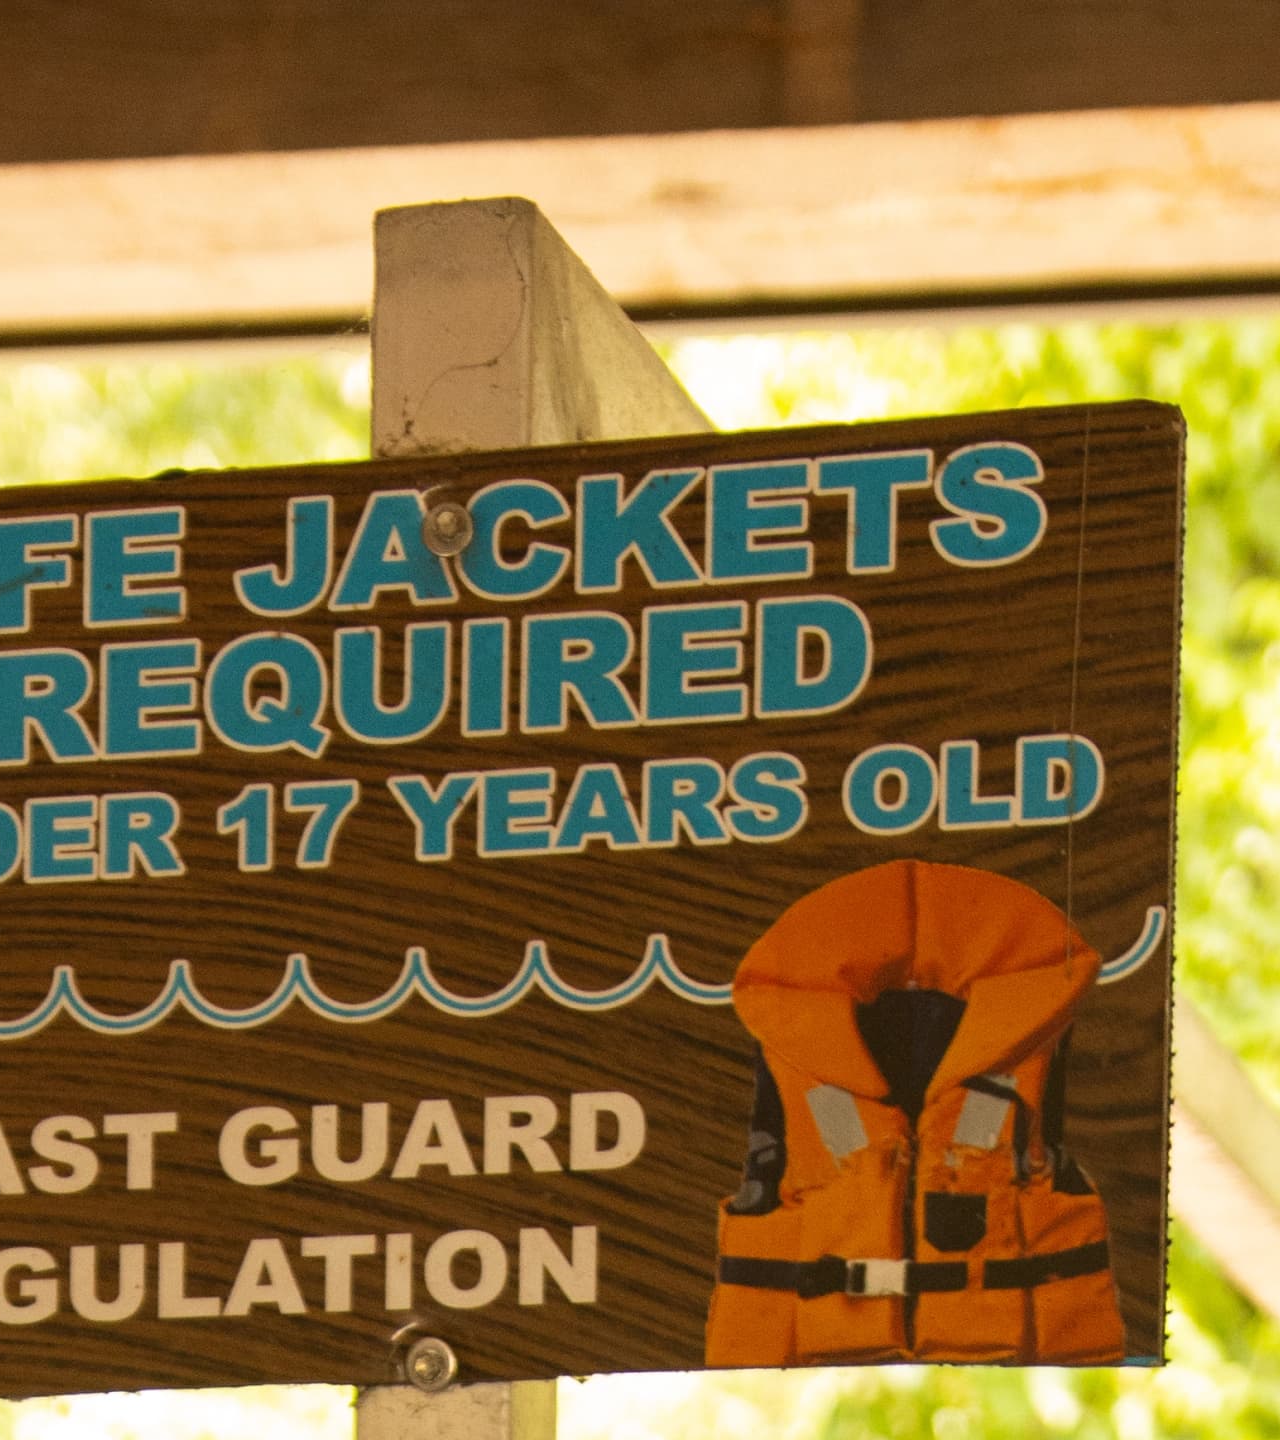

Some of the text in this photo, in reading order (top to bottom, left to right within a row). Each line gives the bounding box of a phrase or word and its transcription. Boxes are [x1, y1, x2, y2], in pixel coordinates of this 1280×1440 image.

[234, 440, 1048, 619] JACKETS
[216, 781, 361, 871] 17
[388, 752, 808, 861] YEARS
[841, 733, 1106, 836] OLD
[217, 1089, 646, 1183] GUARD
